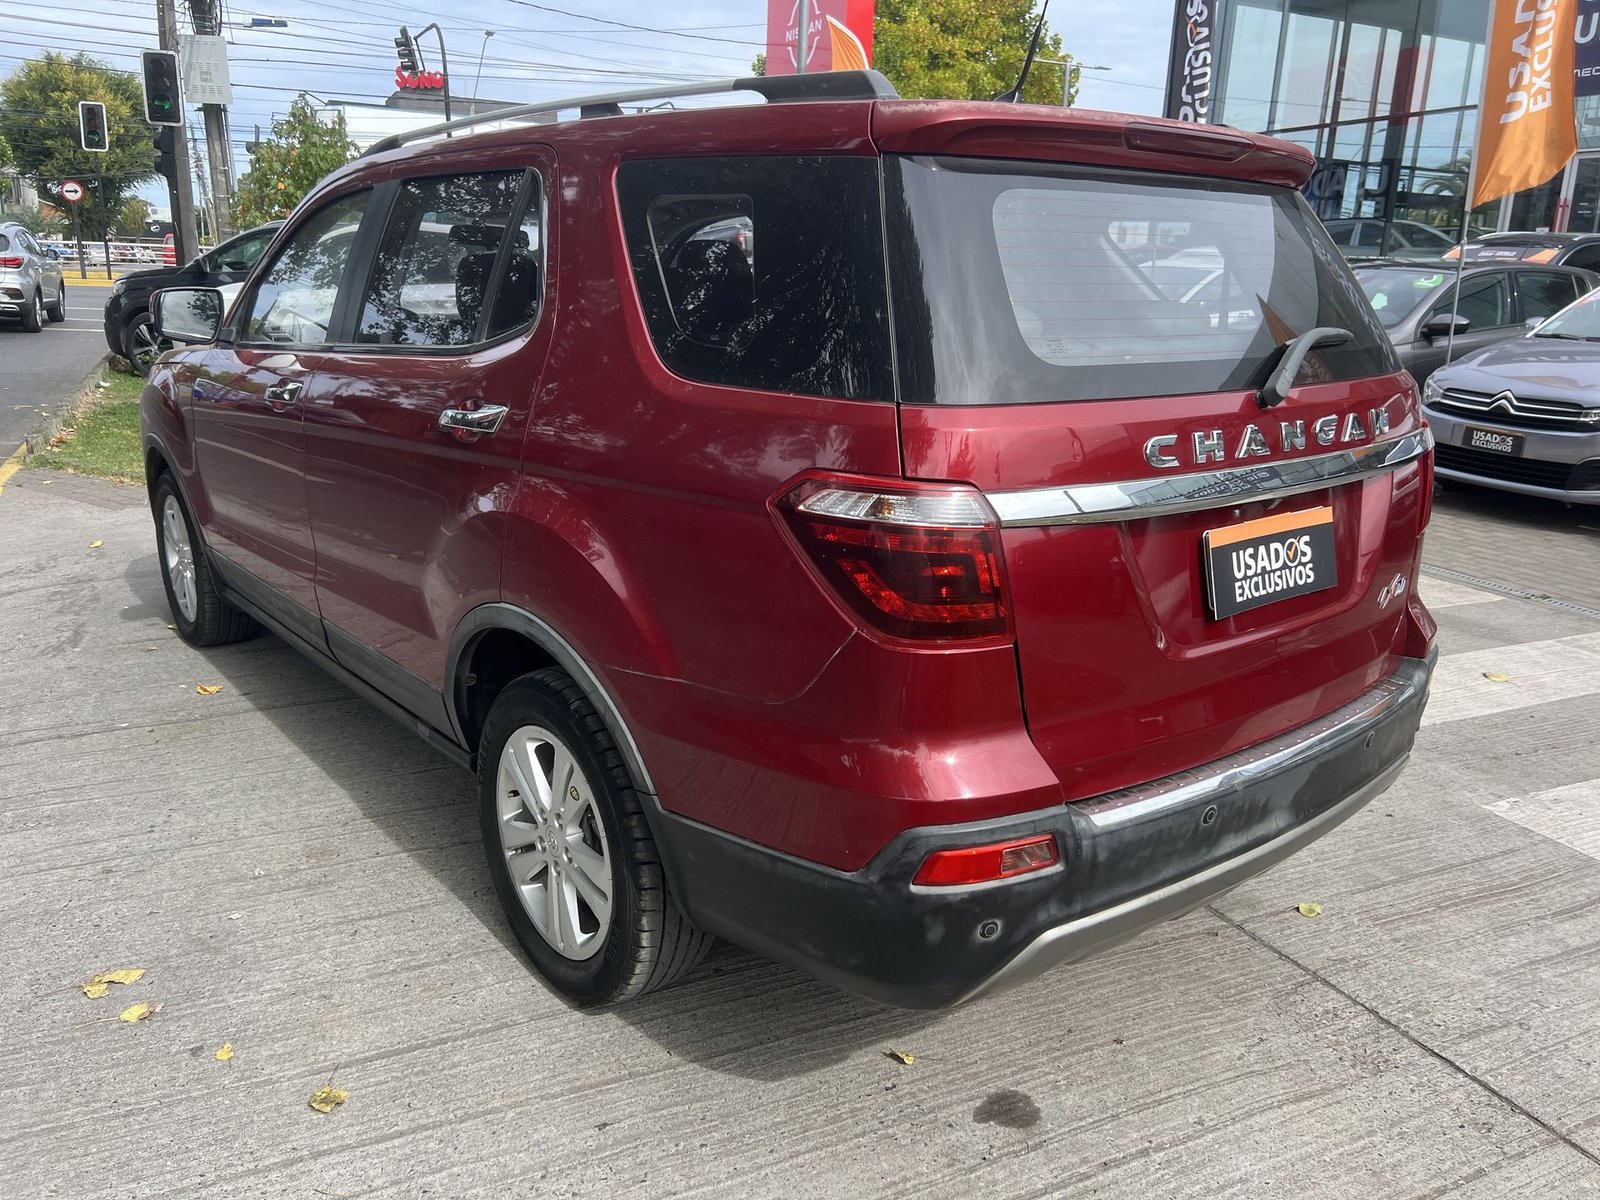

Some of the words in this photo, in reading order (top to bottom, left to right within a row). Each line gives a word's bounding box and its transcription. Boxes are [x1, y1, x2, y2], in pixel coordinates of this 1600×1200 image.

[785, 18, 822, 43] NISAN
[1143, 407, 1390, 469] CHANGAN
[1471, 439, 1512, 453] EXCLUSIVOS
[1472, 430, 1513, 447] USADOS
[1231, 534, 1312, 579] USADOS
[1234, 563, 1315, 603] EXCLUSIVOS
